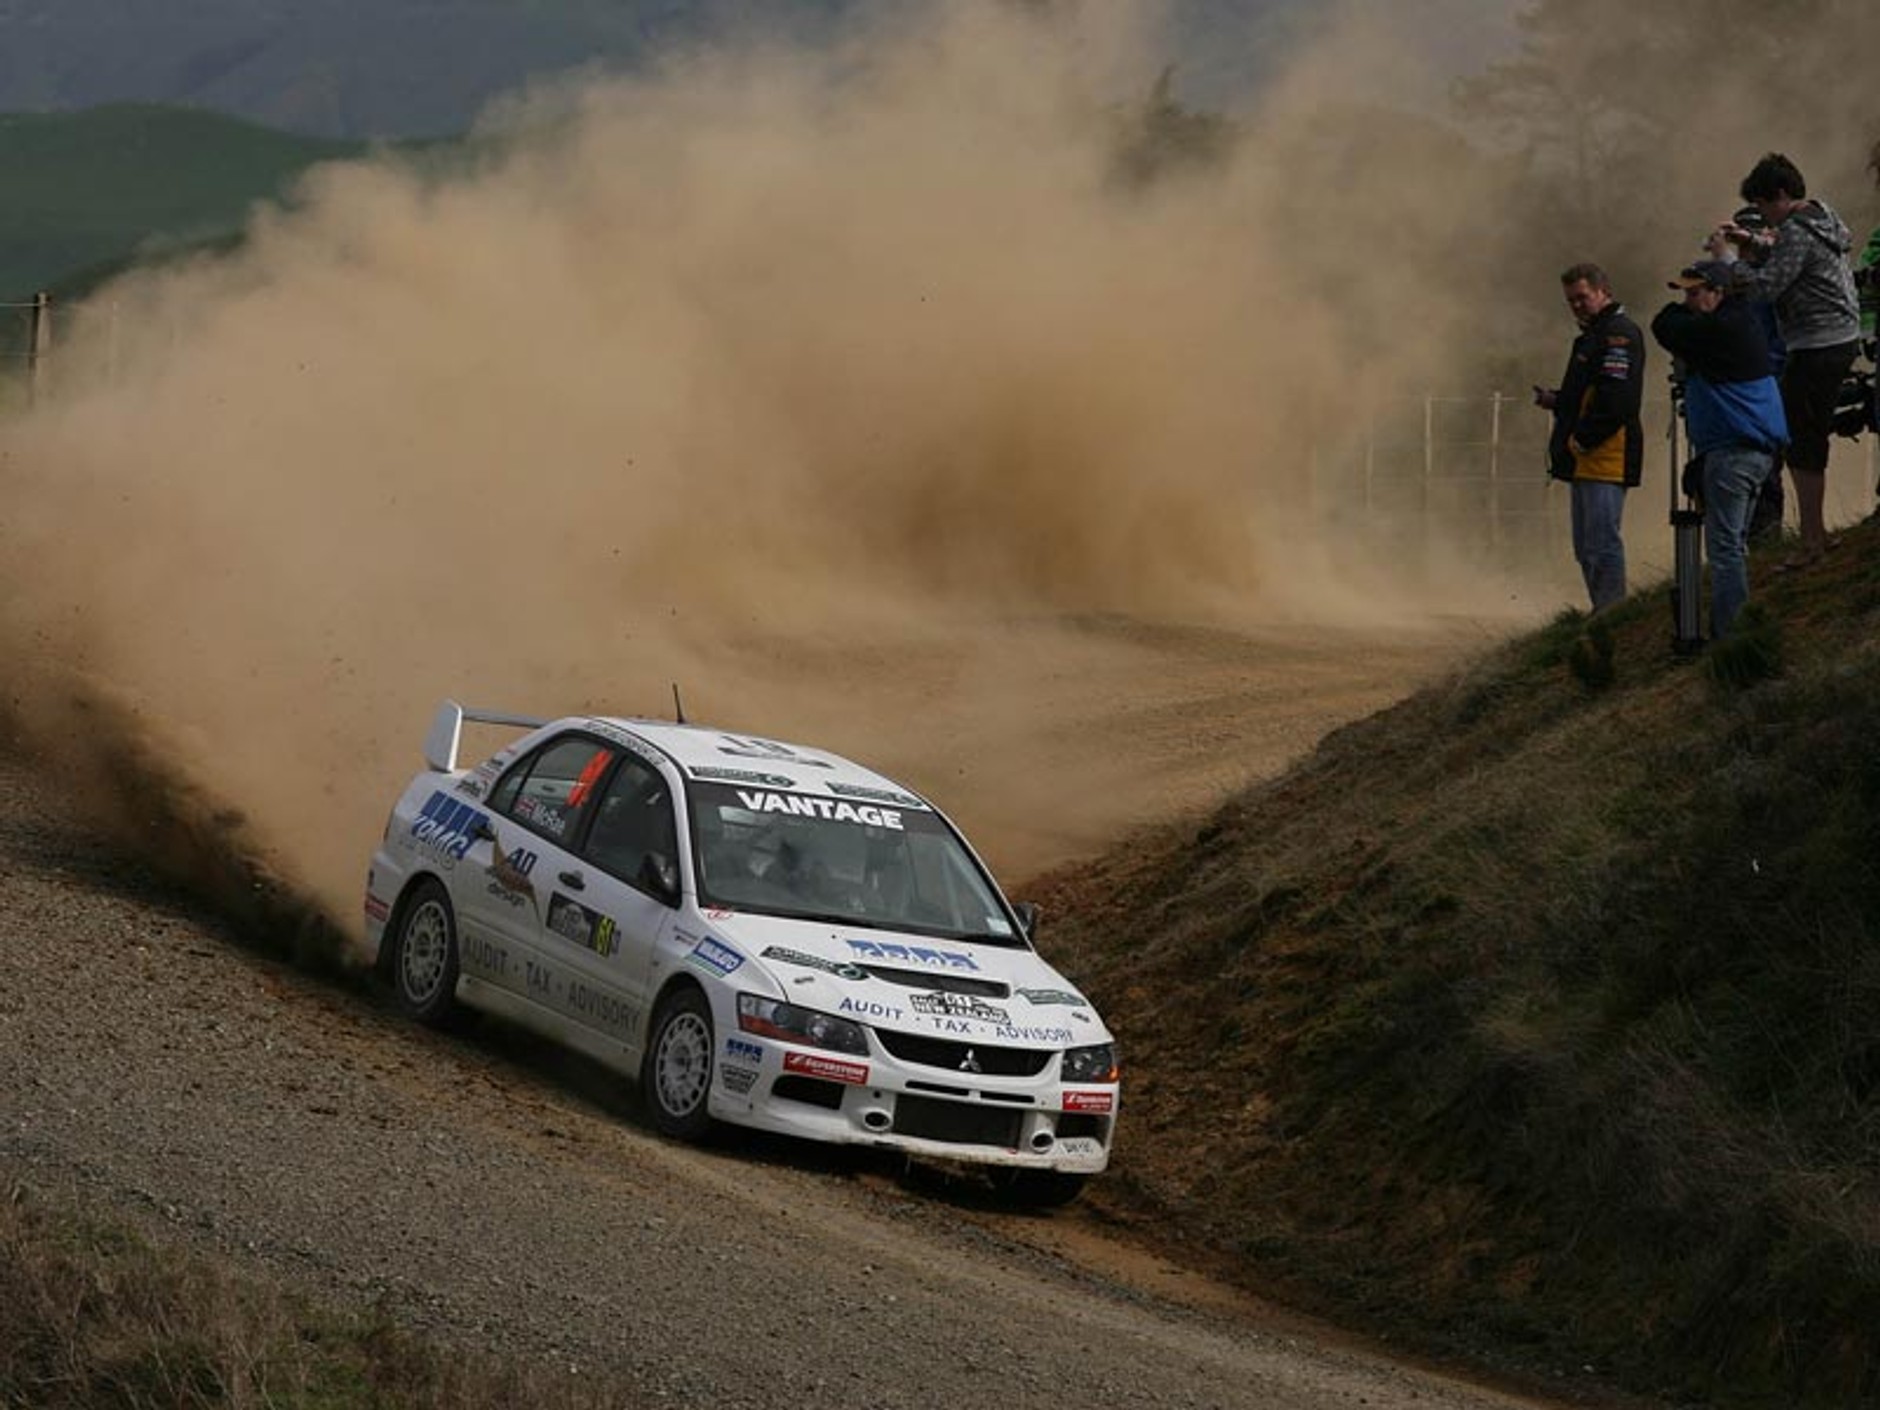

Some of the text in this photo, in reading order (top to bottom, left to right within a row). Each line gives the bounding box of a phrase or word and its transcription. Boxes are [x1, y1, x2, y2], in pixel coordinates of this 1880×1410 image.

[736, 790, 904, 830] VANTAGE
[463, 935, 642, 1032] AUDIT TAX ADVISORY
[839, 996, 903, 1021] AUDIT
[932, 1017, 971, 1034] TAX
